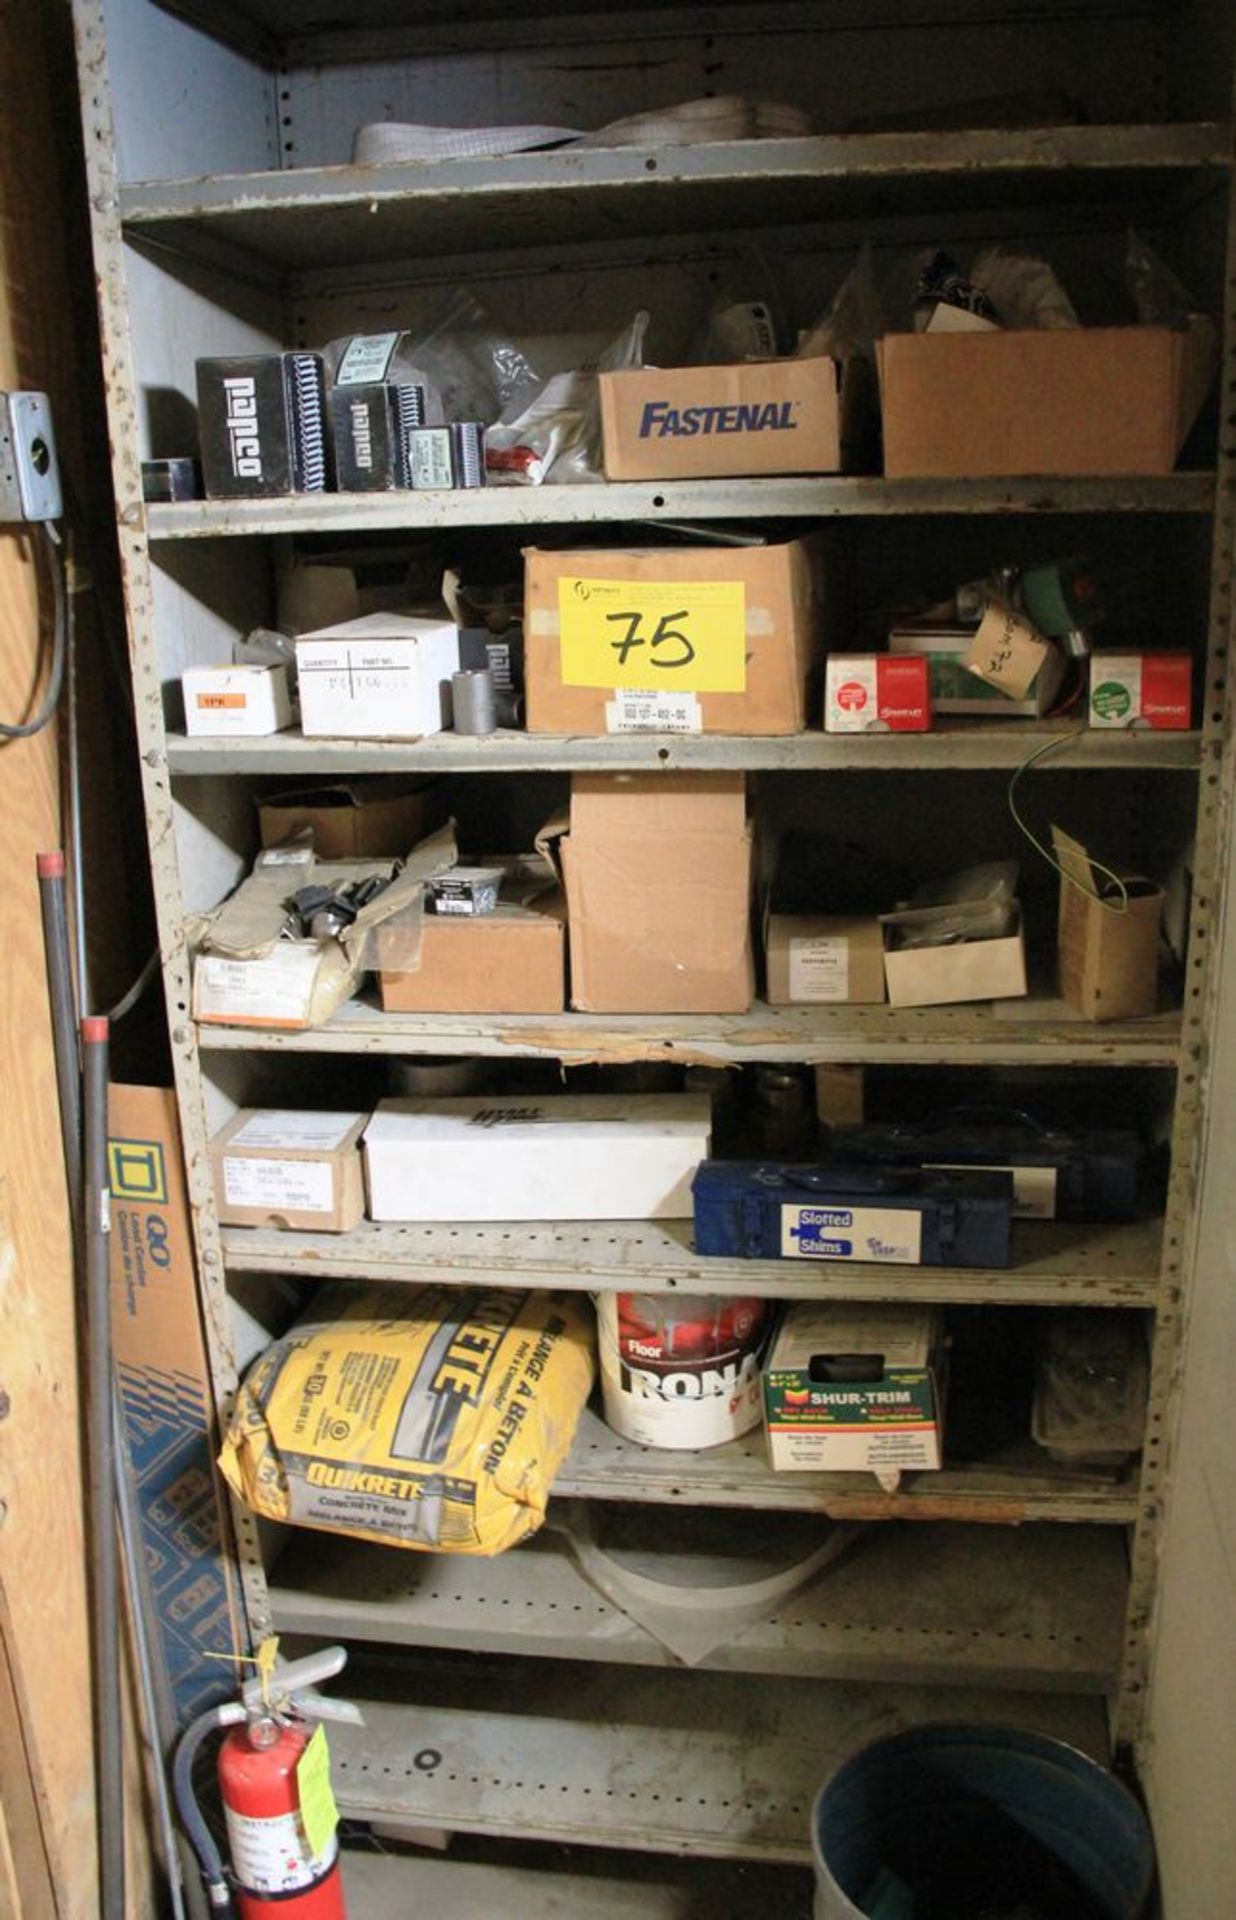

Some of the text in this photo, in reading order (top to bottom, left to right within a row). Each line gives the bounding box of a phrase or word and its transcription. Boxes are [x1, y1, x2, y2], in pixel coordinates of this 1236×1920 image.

[638, 401, 798, 438] FASTENAL
[606, 610, 696, 668] 75
[800, 1210, 851, 1227] Slotted
[800, 1239, 842, 1254] Shims
[627, 1338, 663, 1358] Floor
[810, 1390, 912, 1405] SHUR-TRIM
